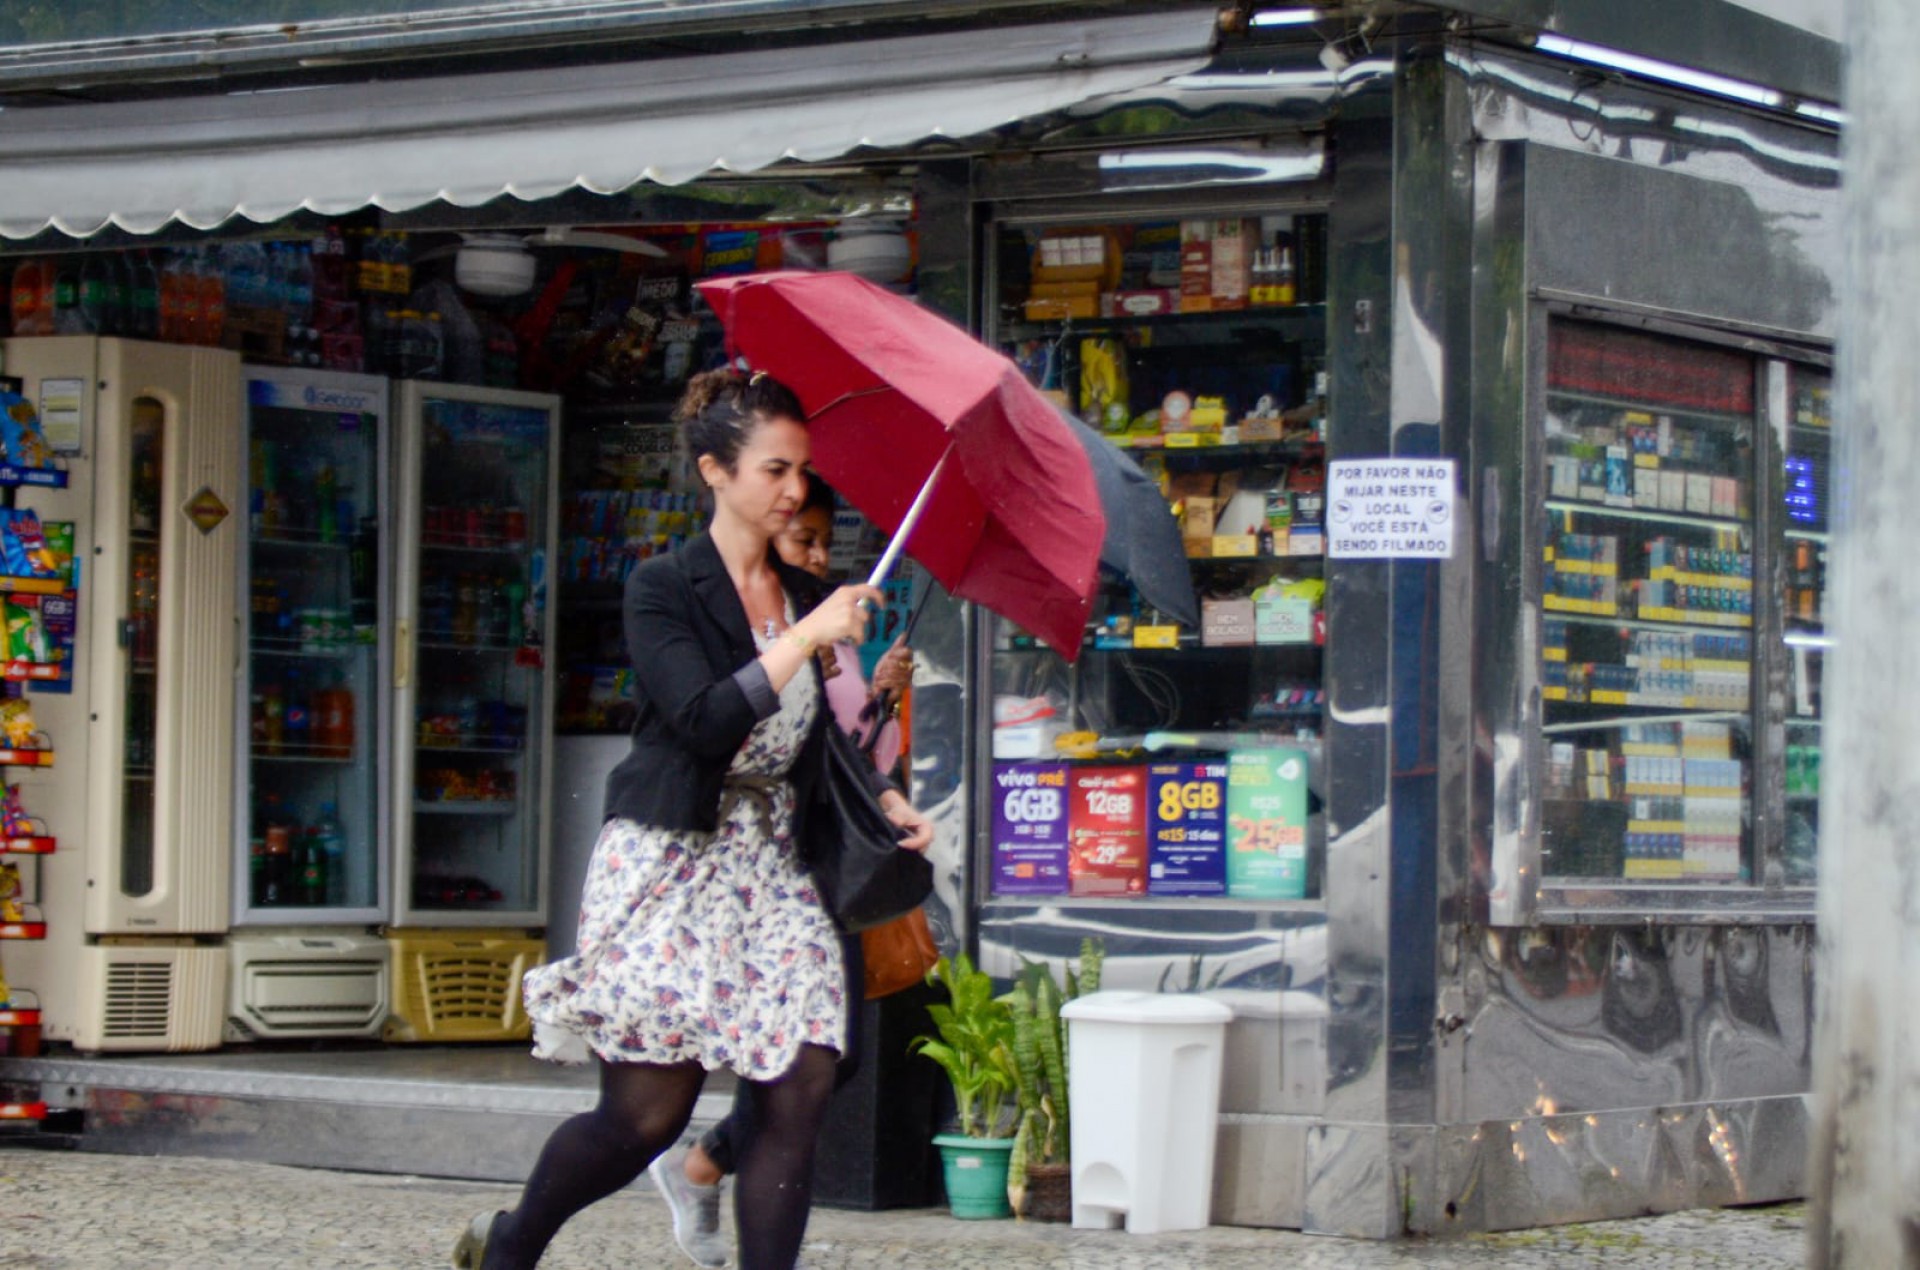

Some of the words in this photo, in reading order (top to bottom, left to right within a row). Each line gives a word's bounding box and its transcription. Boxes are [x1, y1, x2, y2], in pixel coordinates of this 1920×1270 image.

[1335, 467, 1362, 480] POR
[1366, 467, 1410, 479] FAVOR
[1416, 465, 1446, 480] NÃO
[1345, 486, 1383, 497] MIJAR
[1389, 485, 1437, 497] NESTE
[1366, 503, 1412, 515] LOCAL
[1350, 520, 1386, 533] VOCÊ
[1336, 540, 1378, 551] SENDO
[1382, 540, 1446, 551] FILMADO
[997, 768, 1036, 787] vivo
[1038, 769, 1066, 787] PRÉ
[1004, 788, 1061, 822] 6GB
[1086, 790, 1133, 815] 12GB
[1158, 781, 1221, 821] 8GB
